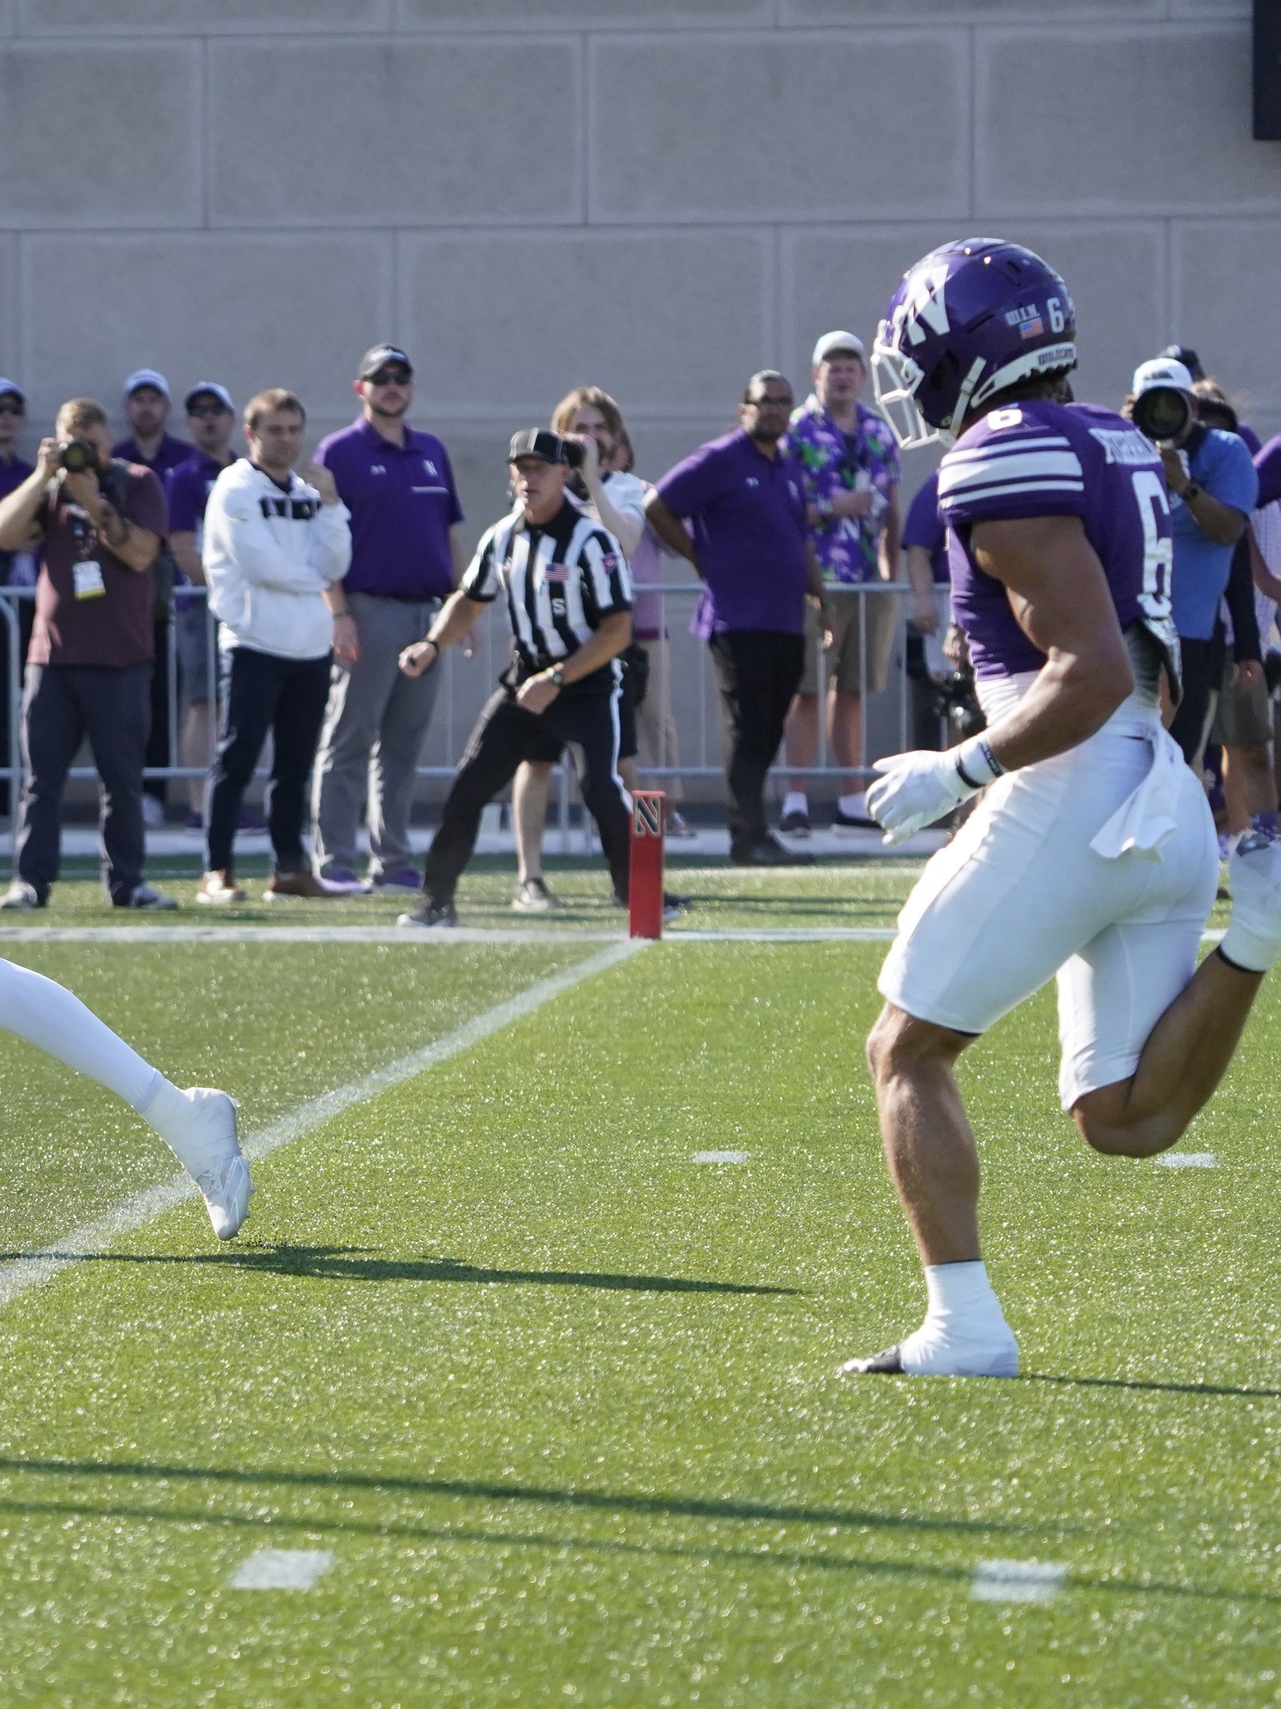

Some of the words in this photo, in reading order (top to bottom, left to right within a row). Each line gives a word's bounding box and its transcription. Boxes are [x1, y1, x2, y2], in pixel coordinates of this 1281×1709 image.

[907, 264, 950, 346] N
[1047, 297, 1065, 334] 6
[987, 402, 1023, 431] 6
[1131, 471, 1173, 618] 6
[551, 597, 567, 616] S
[634, 796, 662, 837] N
